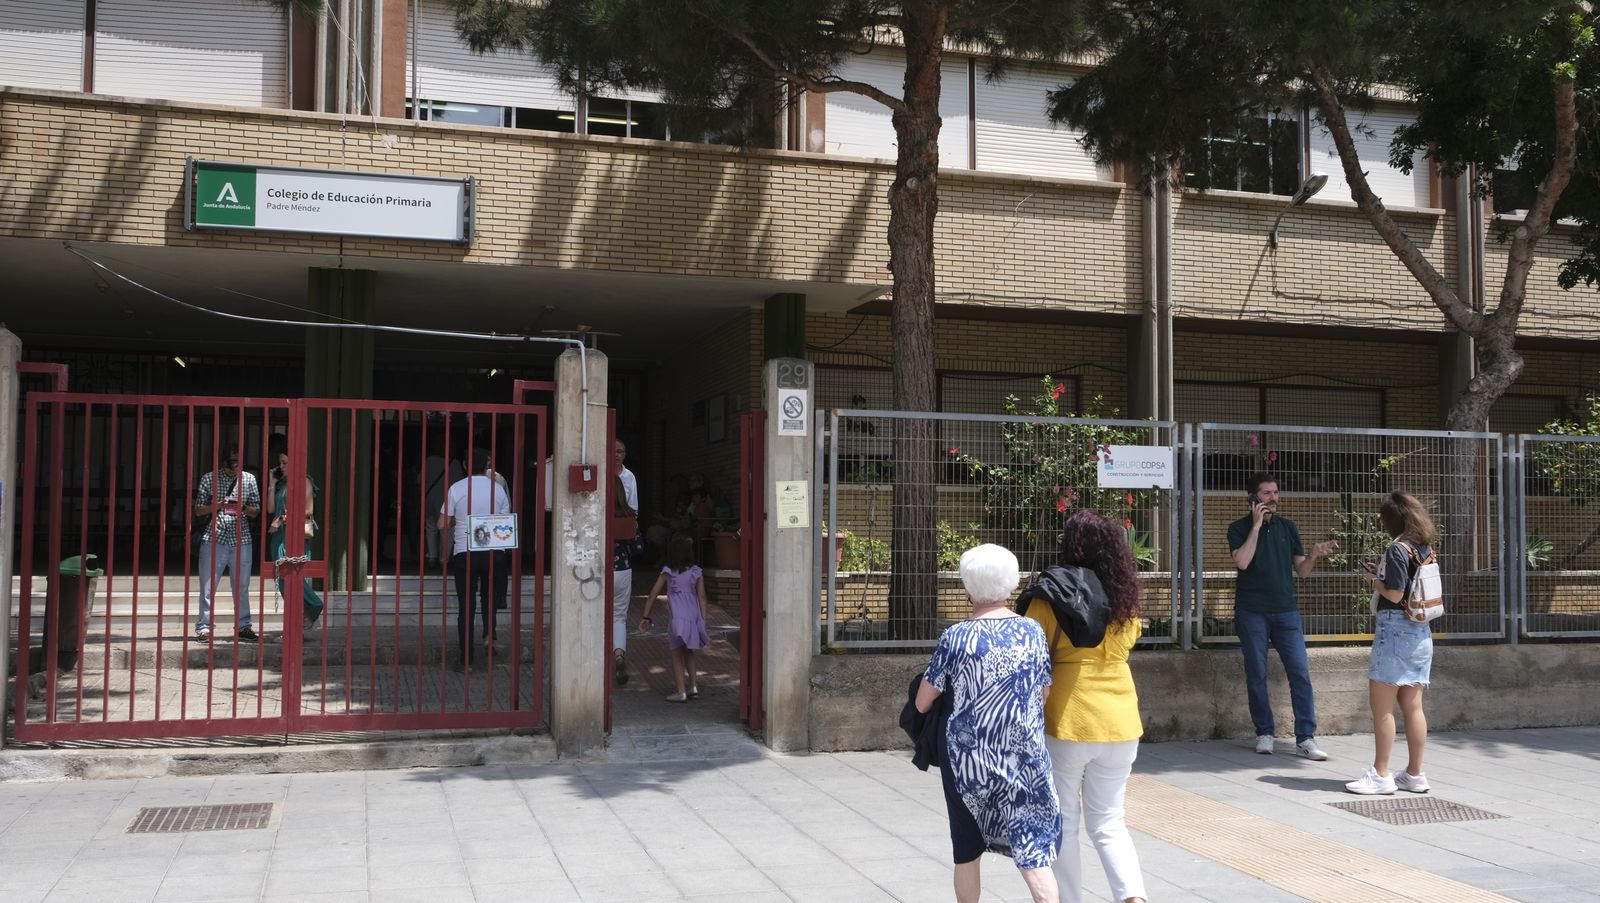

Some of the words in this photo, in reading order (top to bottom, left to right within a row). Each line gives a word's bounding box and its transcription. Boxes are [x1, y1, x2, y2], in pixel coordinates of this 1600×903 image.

[266, 202, 289, 211] Padre
[291, 203, 321, 213] Méndez
[267, 188, 309, 202] Colegio
[311, 190, 325, 201] de
[327, 192, 383, 205] Educación
[386, 196, 432, 208] Primaria
[779, 363, 806, 385] 29
